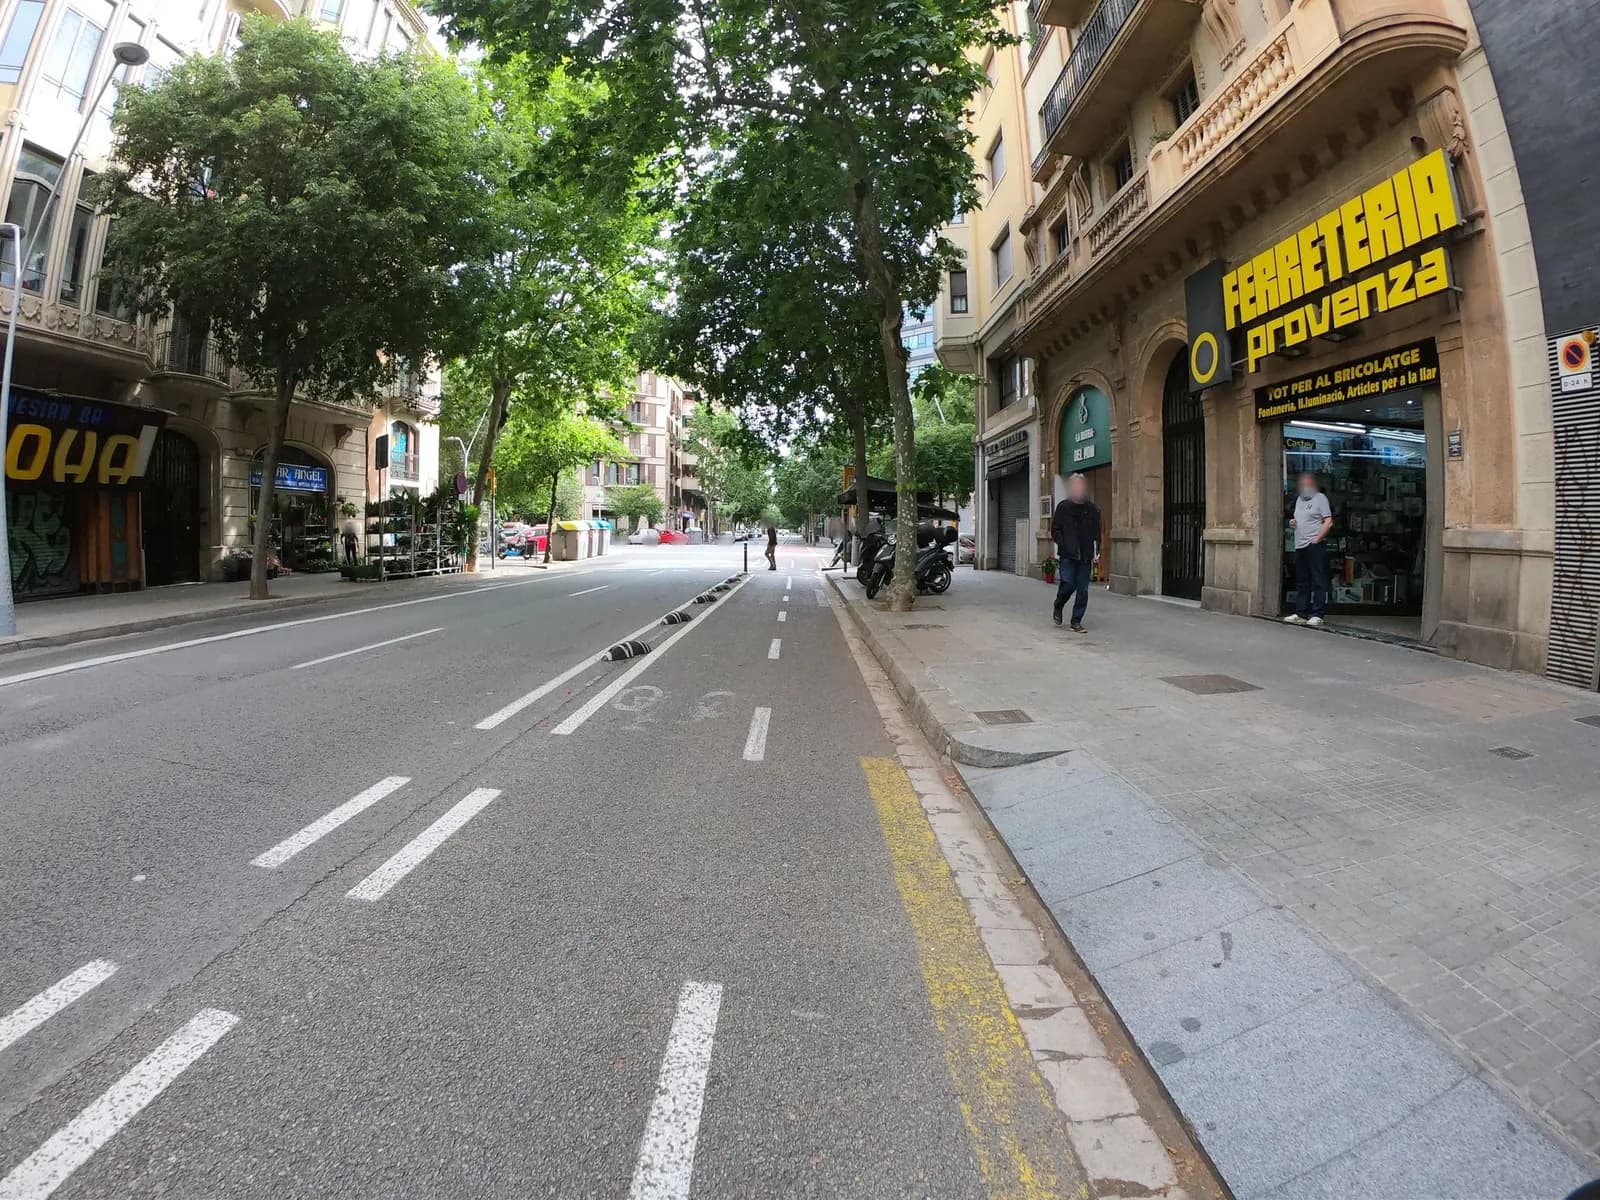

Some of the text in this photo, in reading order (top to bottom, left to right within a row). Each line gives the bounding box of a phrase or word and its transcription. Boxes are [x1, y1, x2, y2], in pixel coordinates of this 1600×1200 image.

[1223, 148, 1458, 331] FERRETERIA
[1247, 247, 1449, 373] provenza
[1267, 348, 1421, 402] TOT PER AL BRICOLATGE
[1347, 381, 1380, 398] Articles
[1382, 376, 1398, 394] per
[1400, 374, 1407, 387] a
[1408, 370, 1418, 385] la
[1420, 367, 1438, 383] llar
[294, 469, 323, 481] ANGEL
